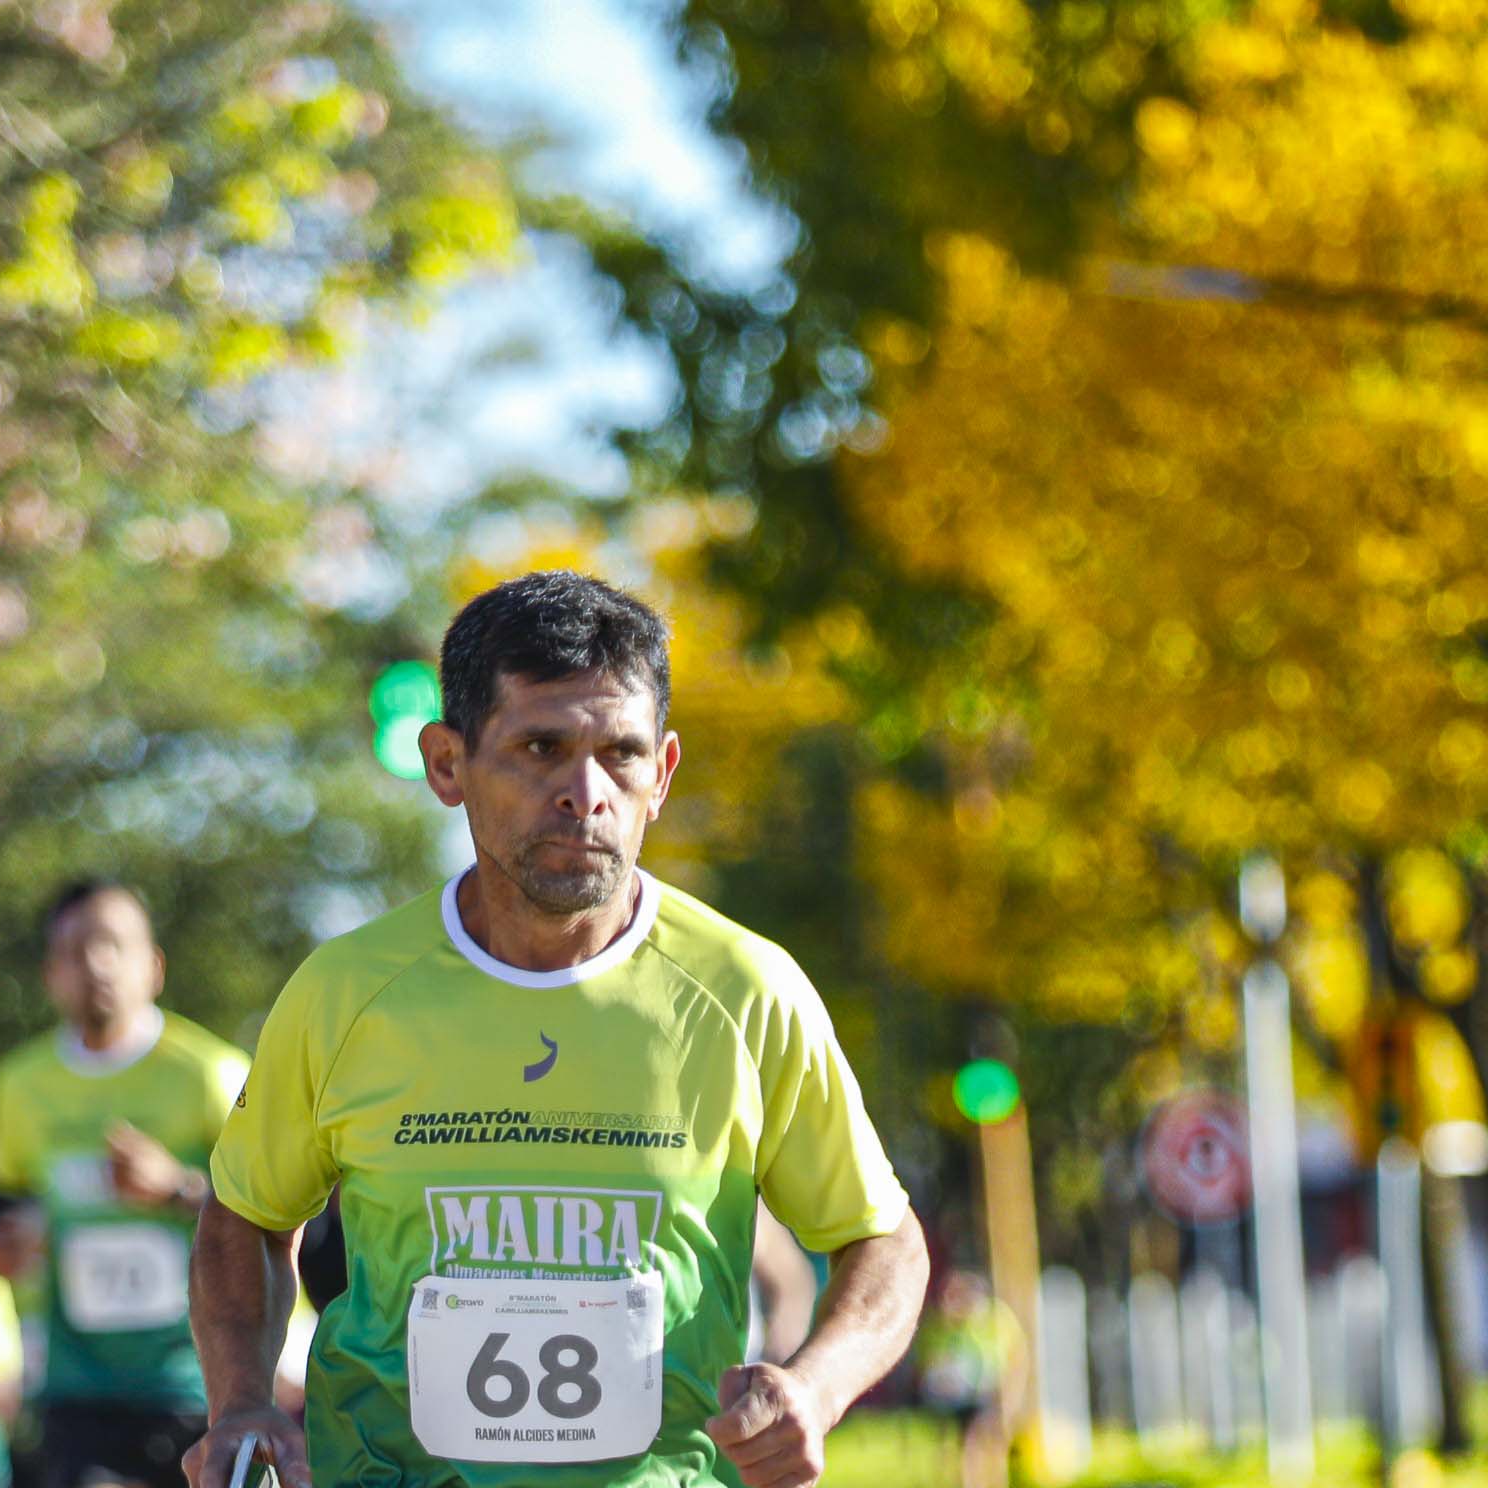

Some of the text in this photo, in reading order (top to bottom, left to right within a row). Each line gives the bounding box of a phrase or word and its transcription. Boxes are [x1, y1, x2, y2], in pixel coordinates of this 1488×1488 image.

[530, 1111, 686, 1130] ANIVERSARIO
[394, 1126, 687, 1148] CAWILLIAMSKEMMIS
[440, 1196, 642, 1266] MAIRA
[466, 1333, 602, 1419] 68
[475, 1426, 596, 1442] RAMÓN ALCIDES MEDINA
